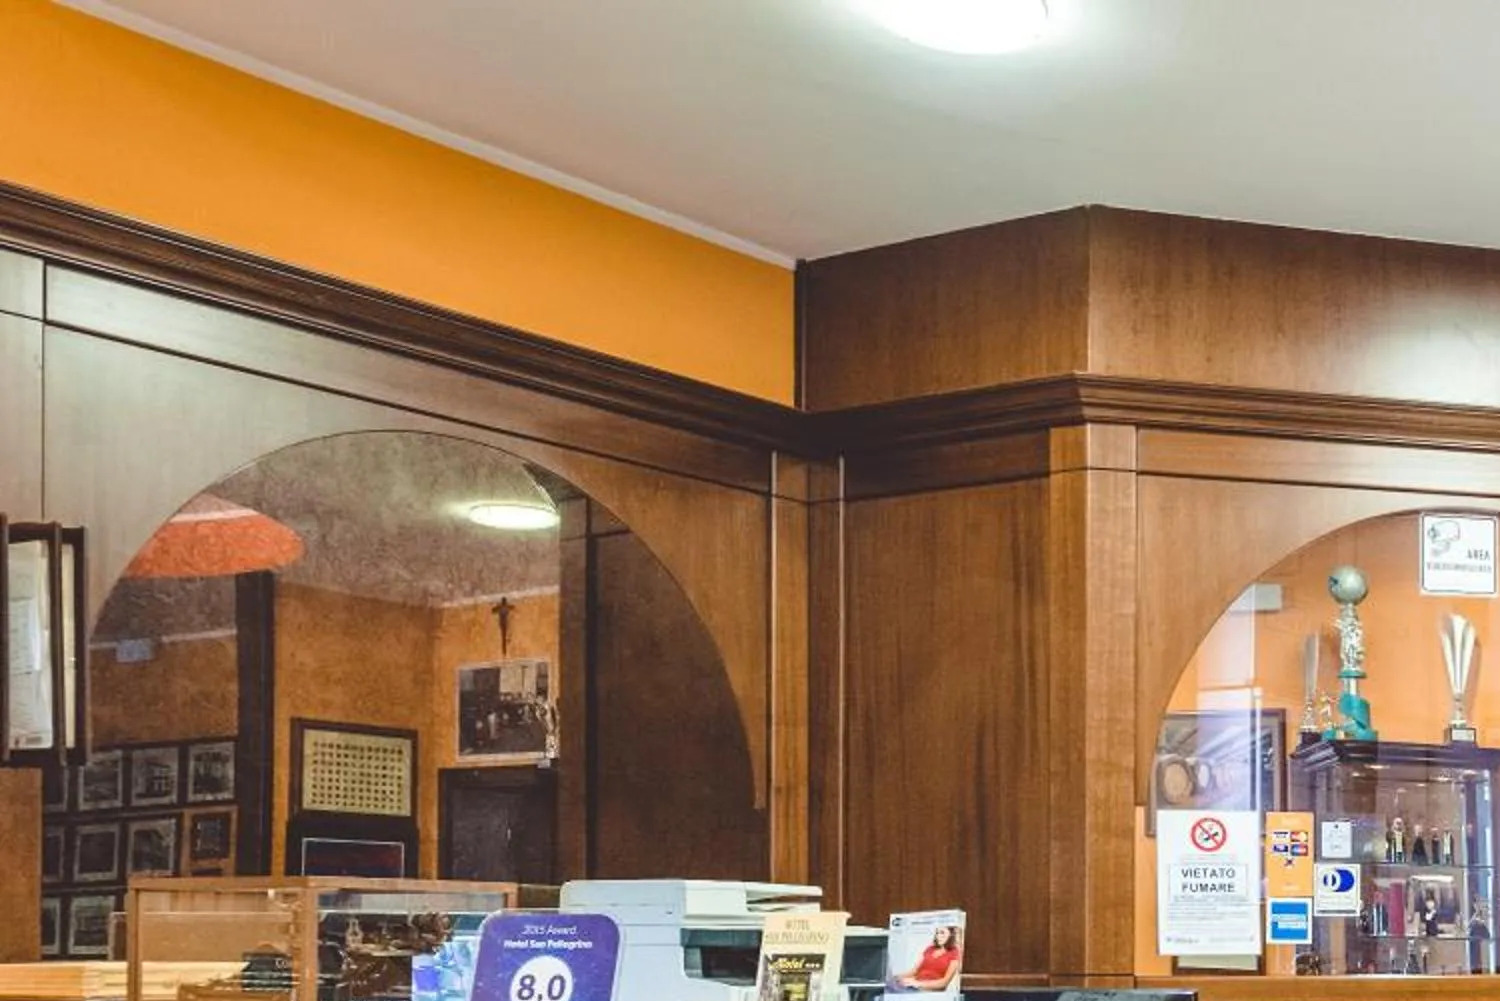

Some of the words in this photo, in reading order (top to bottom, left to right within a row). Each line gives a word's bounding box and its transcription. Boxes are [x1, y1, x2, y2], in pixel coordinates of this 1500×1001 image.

[1181, 867, 1236, 879] VIETATO
[1181, 882, 1236, 893] FUMARE
[547, 925, 577, 935] Award
[503, 939, 529, 949] Hotel
[529, 939, 547, 949] San
[547, 939, 593, 951] Pellegrino
